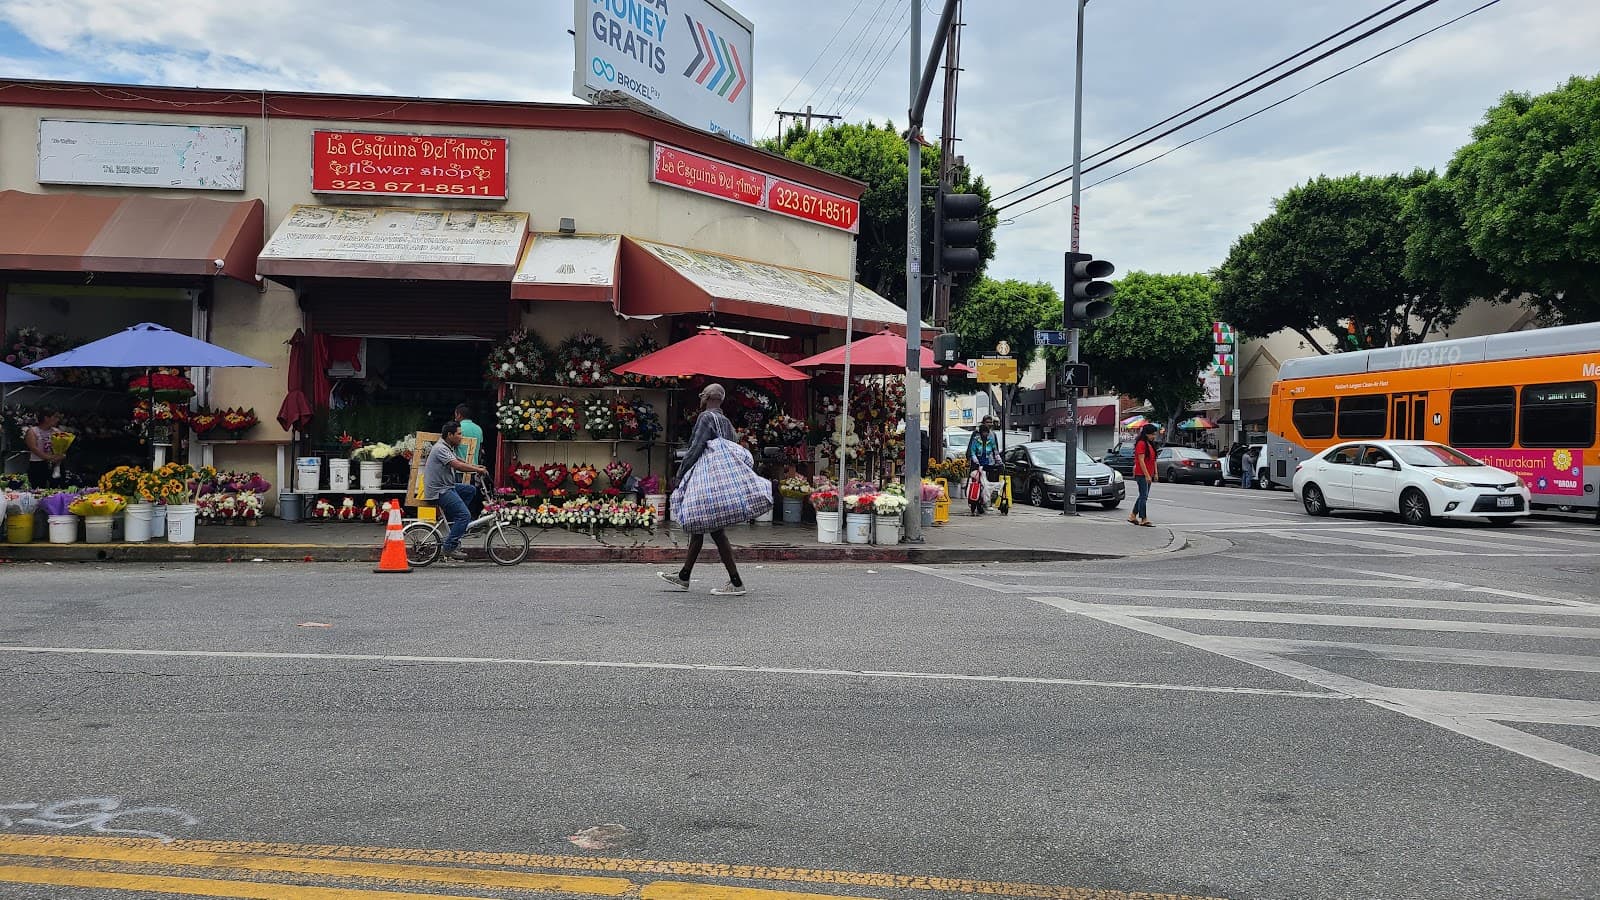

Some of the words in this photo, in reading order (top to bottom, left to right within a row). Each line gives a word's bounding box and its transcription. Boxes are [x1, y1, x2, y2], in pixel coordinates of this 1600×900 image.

[592, 0, 666, 42] ONEY
[592, 11, 666, 75] GRATIS
[327, 138, 347, 155] La
[351, 138, 417, 160] Esquina
[421, 141, 448, 160] Del
[452, 142, 497, 161] Amor
[347, 160, 415, 176] flower
[420, 164, 473, 180] shop
[661, 155, 675, 174] La
[677, 160, 717, 186] Esquina
[718, 171, 735, 190] Del
[736, 178, 761, 197] Amor
[331, 180, 376, 190] 323
[384, 182, 490, 195] 671-8511
[776, 186, 851, 225] 323.671-8511
[1400, 343, 1461, 368] Metro
[1496, 455, 1547, 469] murakami
